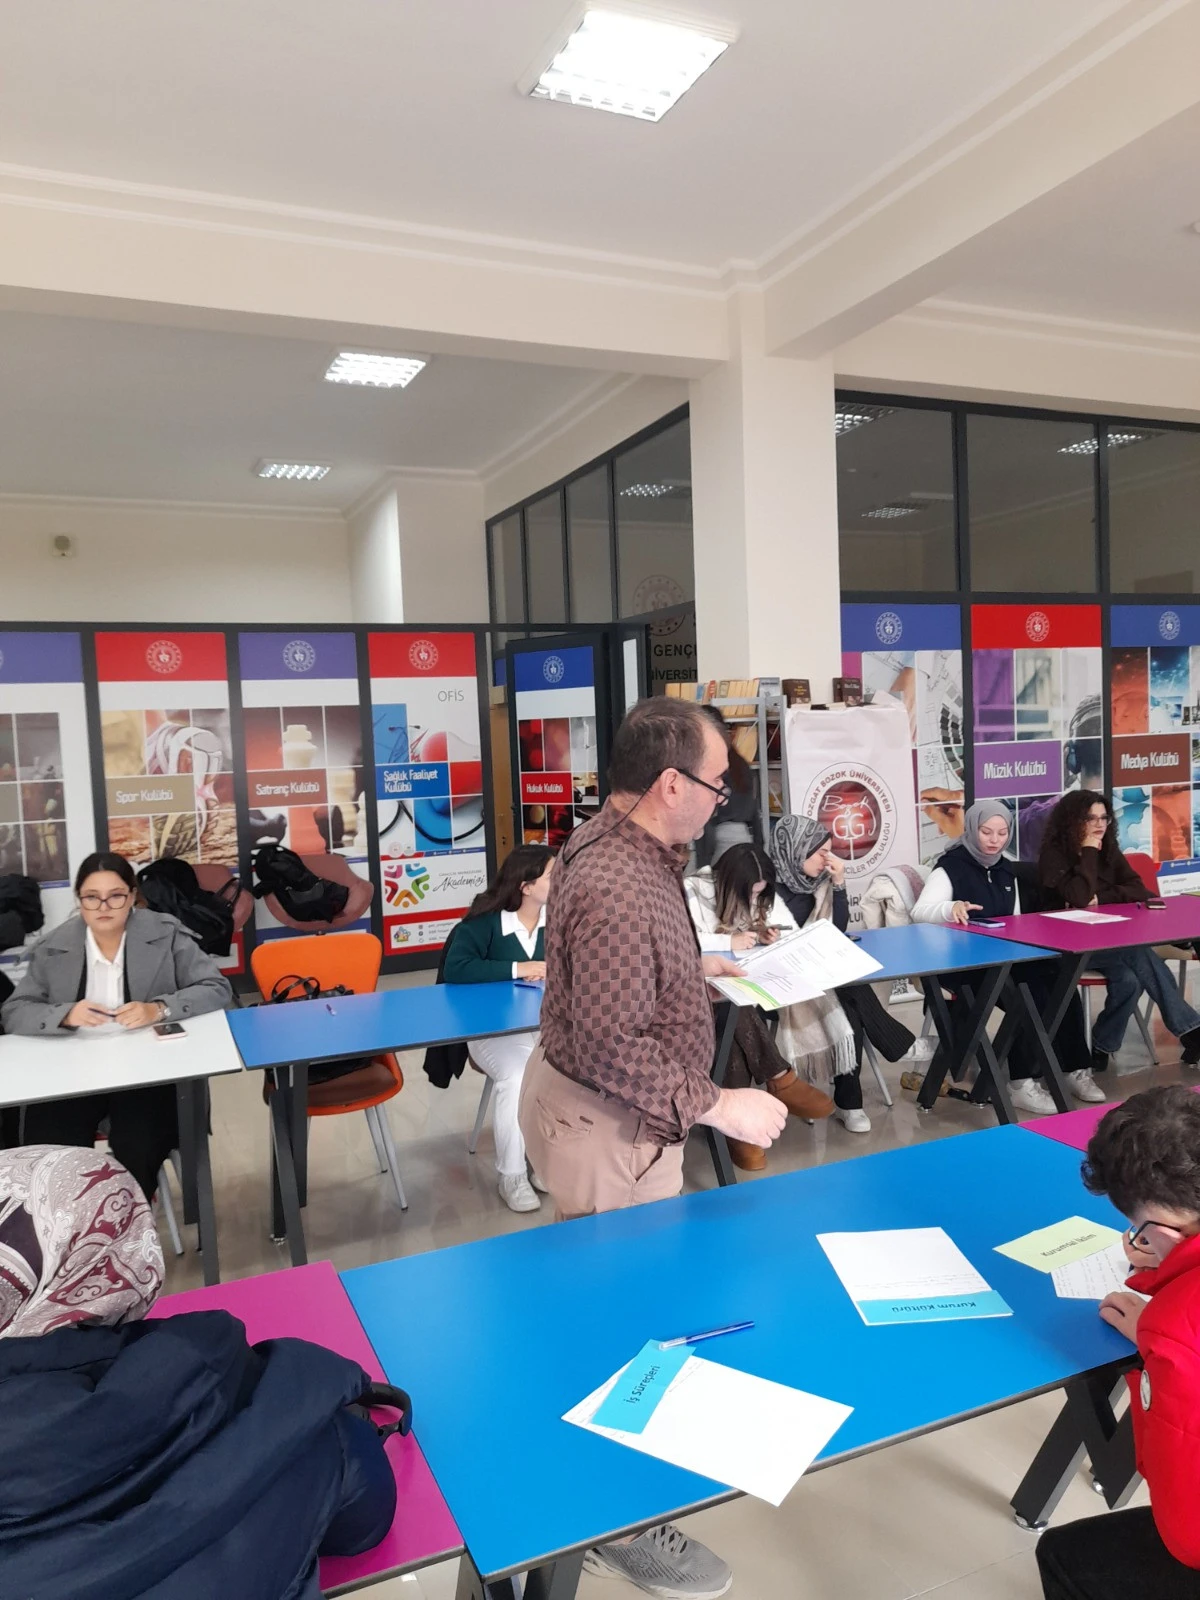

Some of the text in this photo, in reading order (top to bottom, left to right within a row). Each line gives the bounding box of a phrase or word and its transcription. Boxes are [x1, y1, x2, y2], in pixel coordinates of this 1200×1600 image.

[438, 688, 464, 702] OFİS
[1121, 752, 1179, 770] Medya Kulübü
[384, 769, 438, 782] Sağlık Faaliyet
[984, 760, 1047, 779] Müzik Kulübü
[255, 781, 320, 797] Satranç Kulübü
[385, 781, 412, 793] Kulübü
[526, 782, 563, 793] Hukuk Kulübü
[807, 788, 821, 817] OZGAT
[821, 770, 846, 788] BOZOK
[116, 789, 174, 804] Spor Kulübü
[1040, 1240, 1078, 1257] Kurumsal
[891, 1301, 977, 1313] Kurum Kültürü
[631, 1365, 661, 1396] Süreçleri
